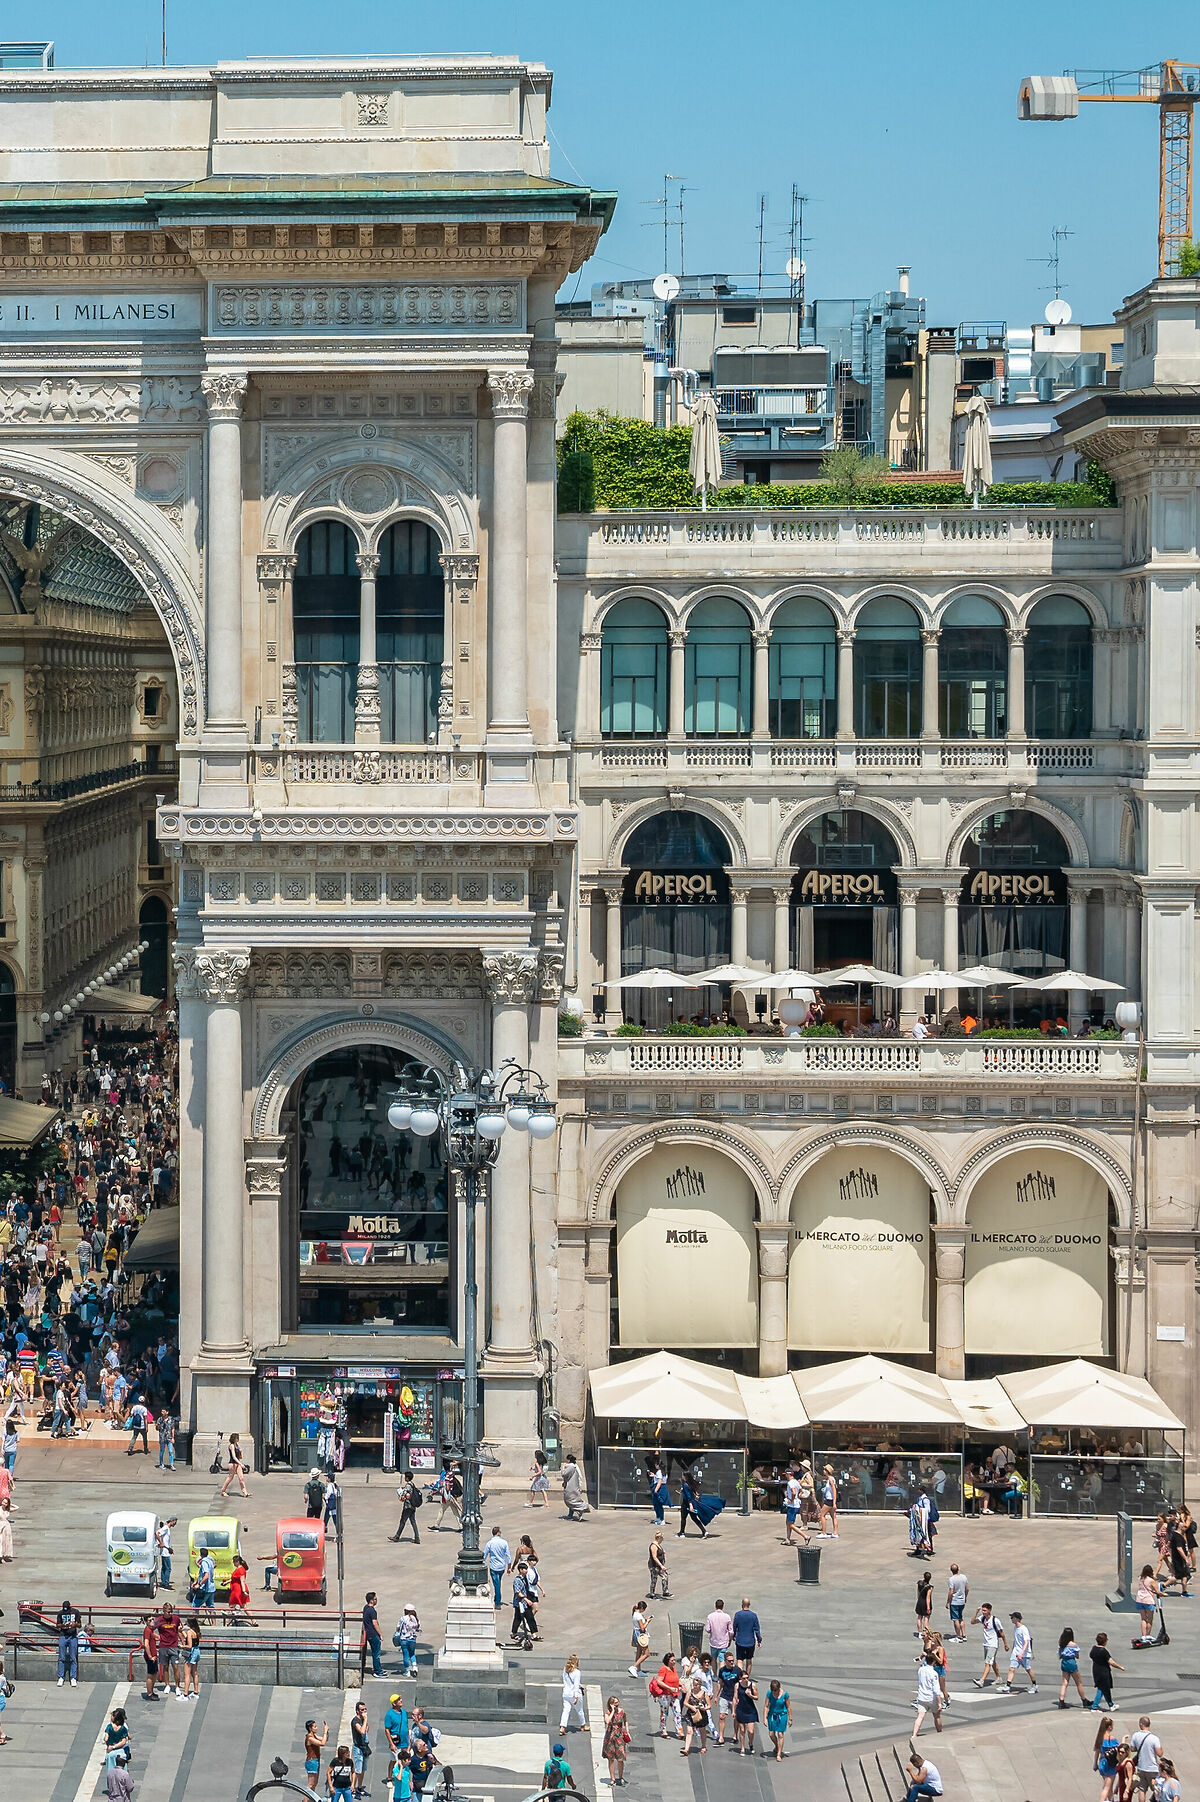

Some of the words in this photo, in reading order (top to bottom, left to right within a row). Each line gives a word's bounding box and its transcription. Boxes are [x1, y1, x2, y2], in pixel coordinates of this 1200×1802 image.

[54, 305, 60, 321] I
[74, 303, 176, 320] MILANESI
[635, 871, 718, 896] APEROL
[801, 870, 885, 895] APEROL
[970, 871, 1055, 896] APEROL
[801, 895, 885, 903] TERRAZZA
[970, 896, 1055, 904] TERRAZZA
[348, 1215, 401, 1234] Motta
[666, 1230, 708, 1243] Motta
[794, 1231, 804, 1240] IL
[806, 1231, 860, 1242] MERCATO
[878, 1233, 924, 1242] DUOMO
[971, 1233, 980, 1242] IL
[982, 1233, 1037, 1243] MERCATO
[1054, 1235, 1102, 1244] DUOMO
